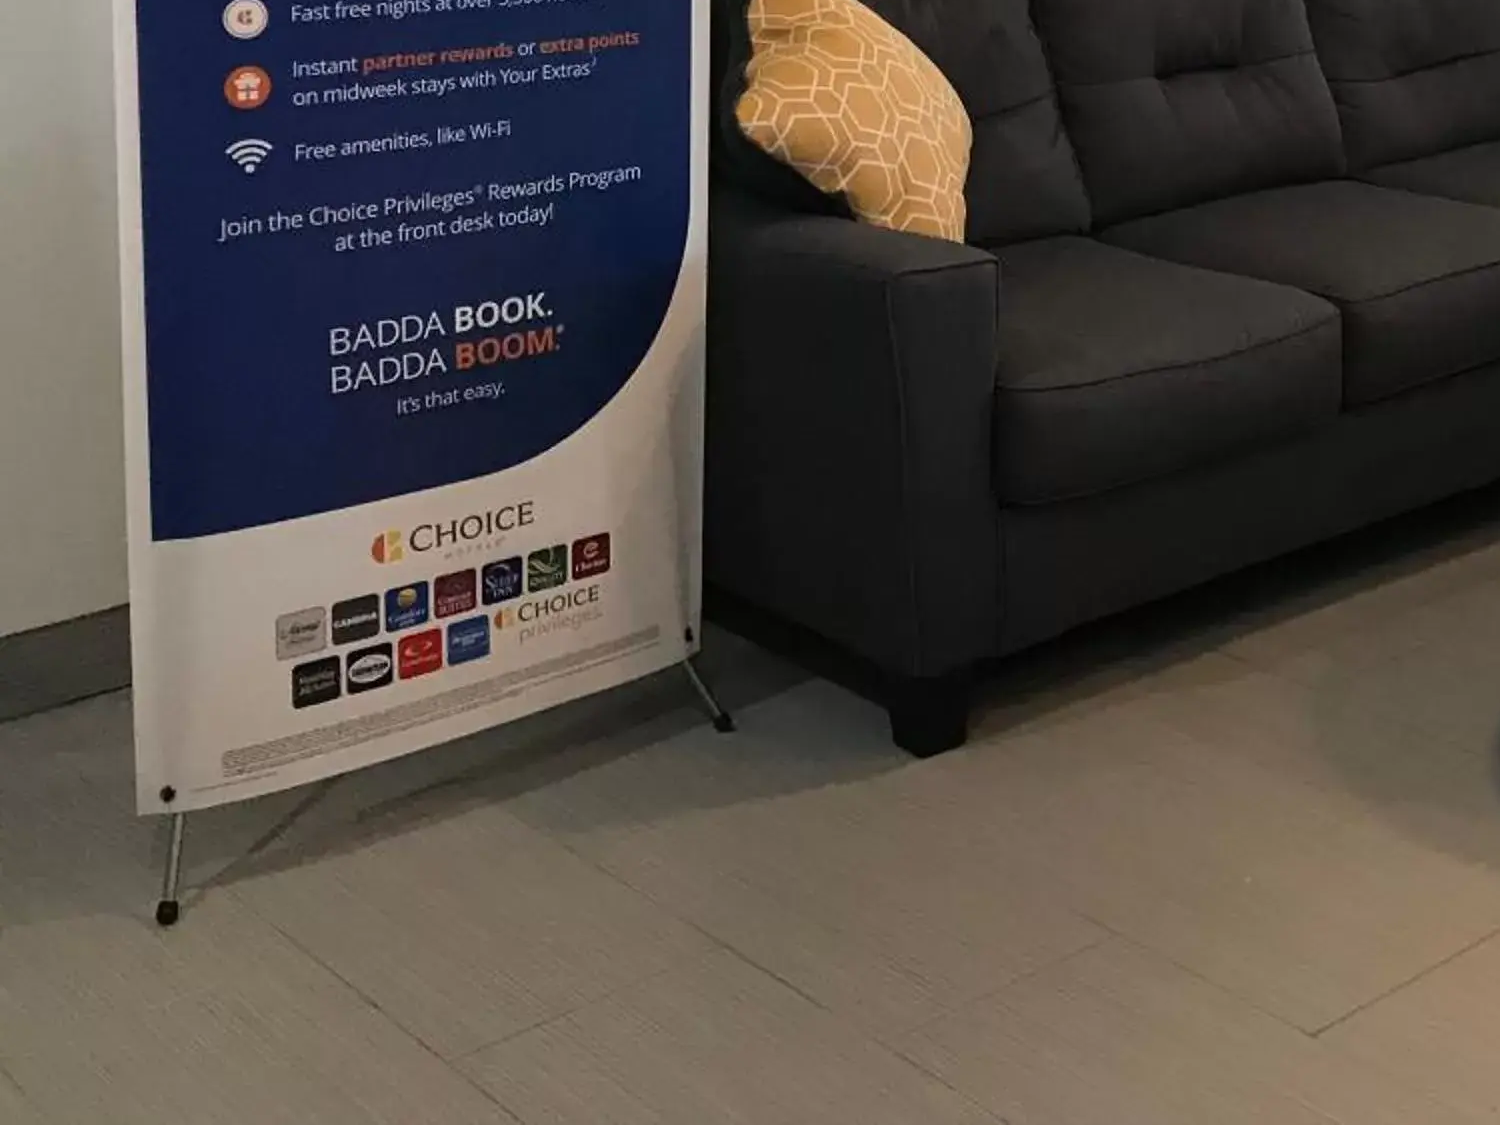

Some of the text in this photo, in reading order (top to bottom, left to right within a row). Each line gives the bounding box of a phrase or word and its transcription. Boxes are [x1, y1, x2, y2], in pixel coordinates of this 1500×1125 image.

[290, 2, 331, 24] Fast
[292, 29, 641, 79] Instant partner rewards or extra points
[292, 89, 319, 106] on
[323, 79, 408, 104] midweek
[411, 75, 456, 97] stays
[459, 68, 497, 90] with
[499, 67, 537, 86] Your
[294, 119, 512, 162] Free amenities, like Wi-Fi
[217, 217, 262, 243] Join
[268, 210, 303, 232] the
[309, 202, 379, 228] Choice
[488, 175, 565, 202] Rewards
[568, 164, 641, 191] Program
[334, 202, 555, 253] at the front desk today!
[329, 291, 553, 356] BADDA BOOK.
[330, 347, 447, 395] BADDA
[396, 381, 506, 417] It's that easy.
[409, 500, 535, 552] CHOICE
[517, 584, 600, 622] CHOICE
